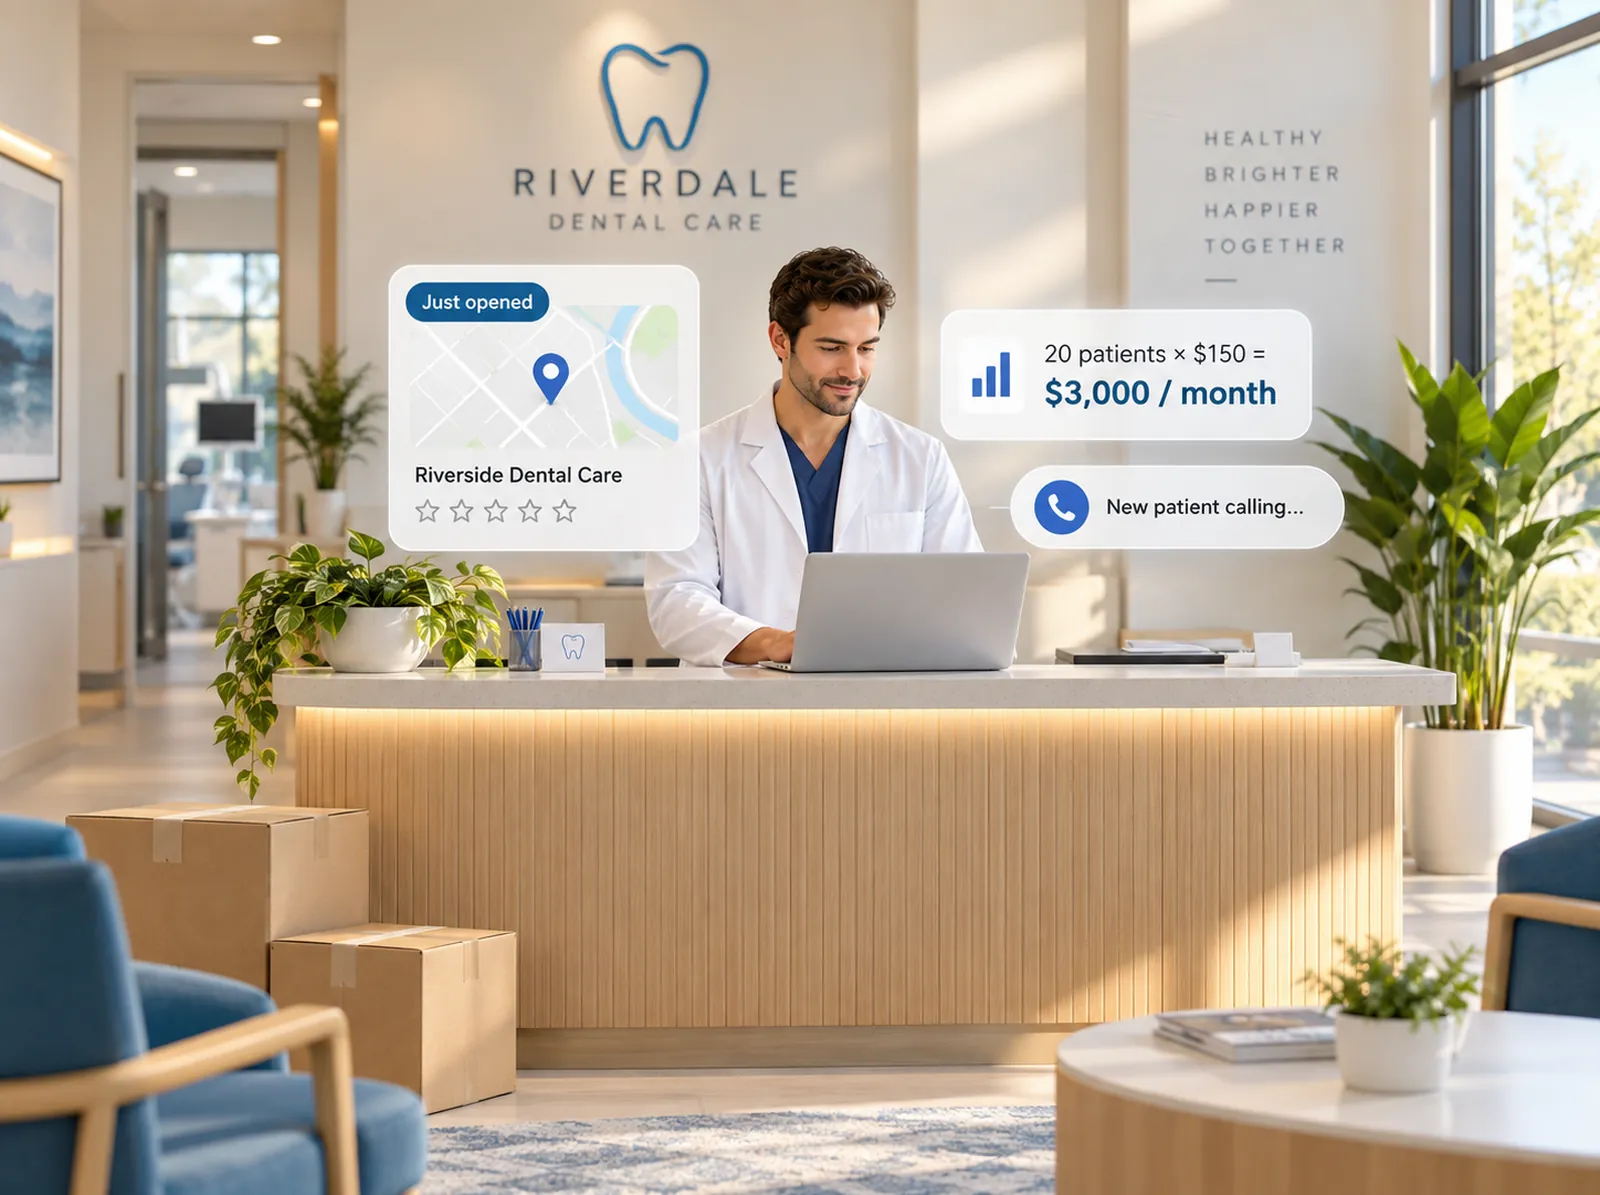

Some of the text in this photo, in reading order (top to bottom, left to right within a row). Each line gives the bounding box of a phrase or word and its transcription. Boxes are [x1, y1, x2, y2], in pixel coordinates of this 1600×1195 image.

[1204, 129, 1322, 147] HEALTHY
[513, 168, 798, 198] RIVERDALE
[1204, 165, 1339, 183] BRIGHTER
[1204, 202, 1318, 219] HAPPIER
[548, 212, 761, 232] DENTAL CARE
[1204, 237, 1345, 255] TOGETHER
